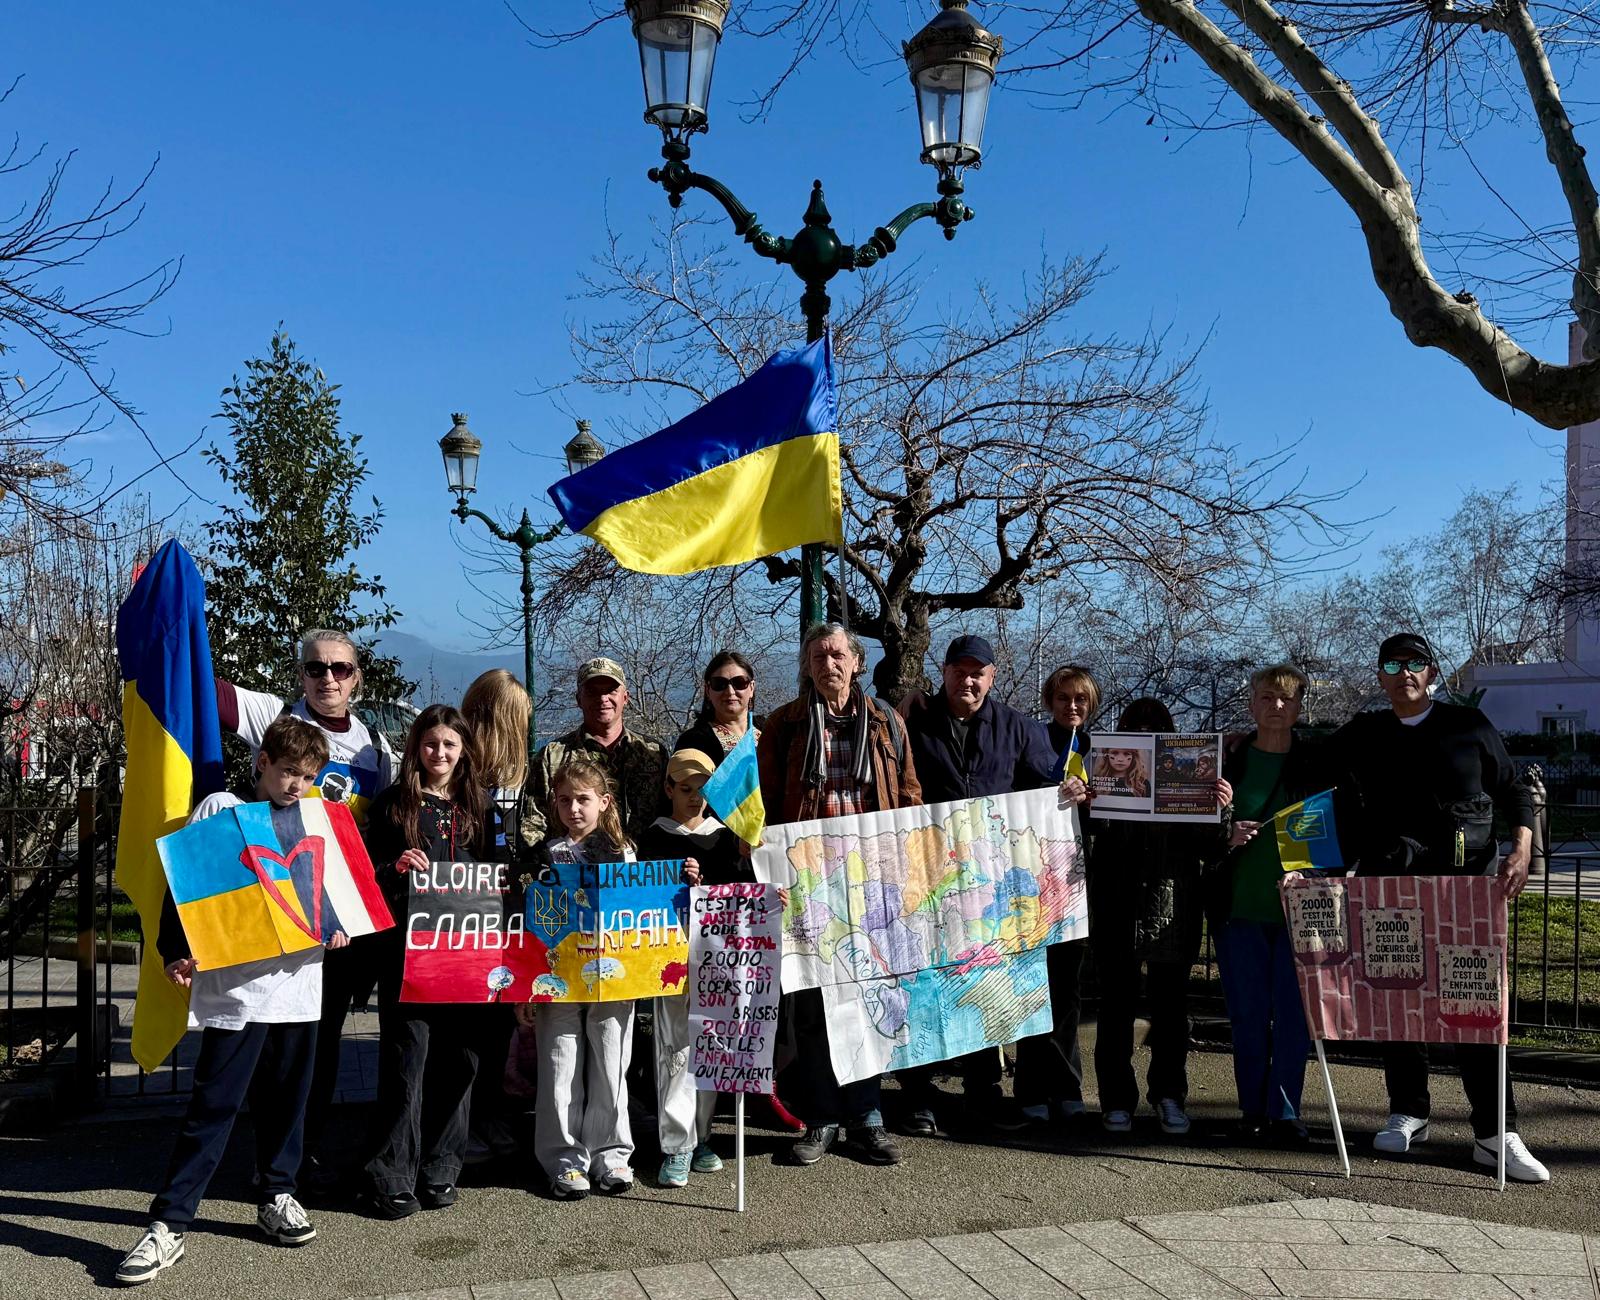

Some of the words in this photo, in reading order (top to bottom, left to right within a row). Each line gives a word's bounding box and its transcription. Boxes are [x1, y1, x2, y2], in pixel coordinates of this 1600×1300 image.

[707, 883, 766, 899] 20000
[695, 897, 733, 912] C'EST
[736, 896, 766, 912] PAS
[1301, 898, 1334, 910] 20000
[699, 910, 742, 925] JUSTE
[748, 910, 768, 925] LE
[1302, 911, 1320, 920] C'EST
[1322, 911, 1336, 919] PAS
[407, 912, 525, 950] СЛАВА
[701, 925, 739, 937] CODE
[1304, 920, 1325, 929] JUSTE
[1326, 920, 1335, 928] LE
[1375, 921, 1409, 932] 20000
[1299, 929, 1317, 938] CODE
[1318, 929, 1344, 937] POSTAL
[1376, 935, 1395, 943] C'EST
[1396, 935, 1409, 943] LES
[724, 934, 777, 950] POSTAL
[1406, 944, 1418, 953] QUI
[702, 951, 763, 968] 20000
[1369, 954, 1390, 963] SONT
[1452, 957, 1487, 969] 20000
[698, 965, 739, 980] C'EST
[746, 966, 774, 980] DES
[1452, 971, 1473, 979] C'EST
[1474, 971, 1487, 980] LES
[745, 980, 771, 996] QUI
[1449, 981, 1483, 990] ENFANTS
[1484, 981, 1497, 991] QUI
[698, 993, 741, 1008] SONT
[733, 1006, 779, 1022] BRISES
[702, 1020, 762, 1036] 20000
[695, 1035, 735, 1052] C'EST
[738, 1036, 765, 1053] LES
[694, 1050, 755, 1068] ENFANTS
[695, 1065, 719, 1079] QUI
[720, 1066, 772, 1081] ETAIENT
[713, 1079, 762, 1094] VOLES
